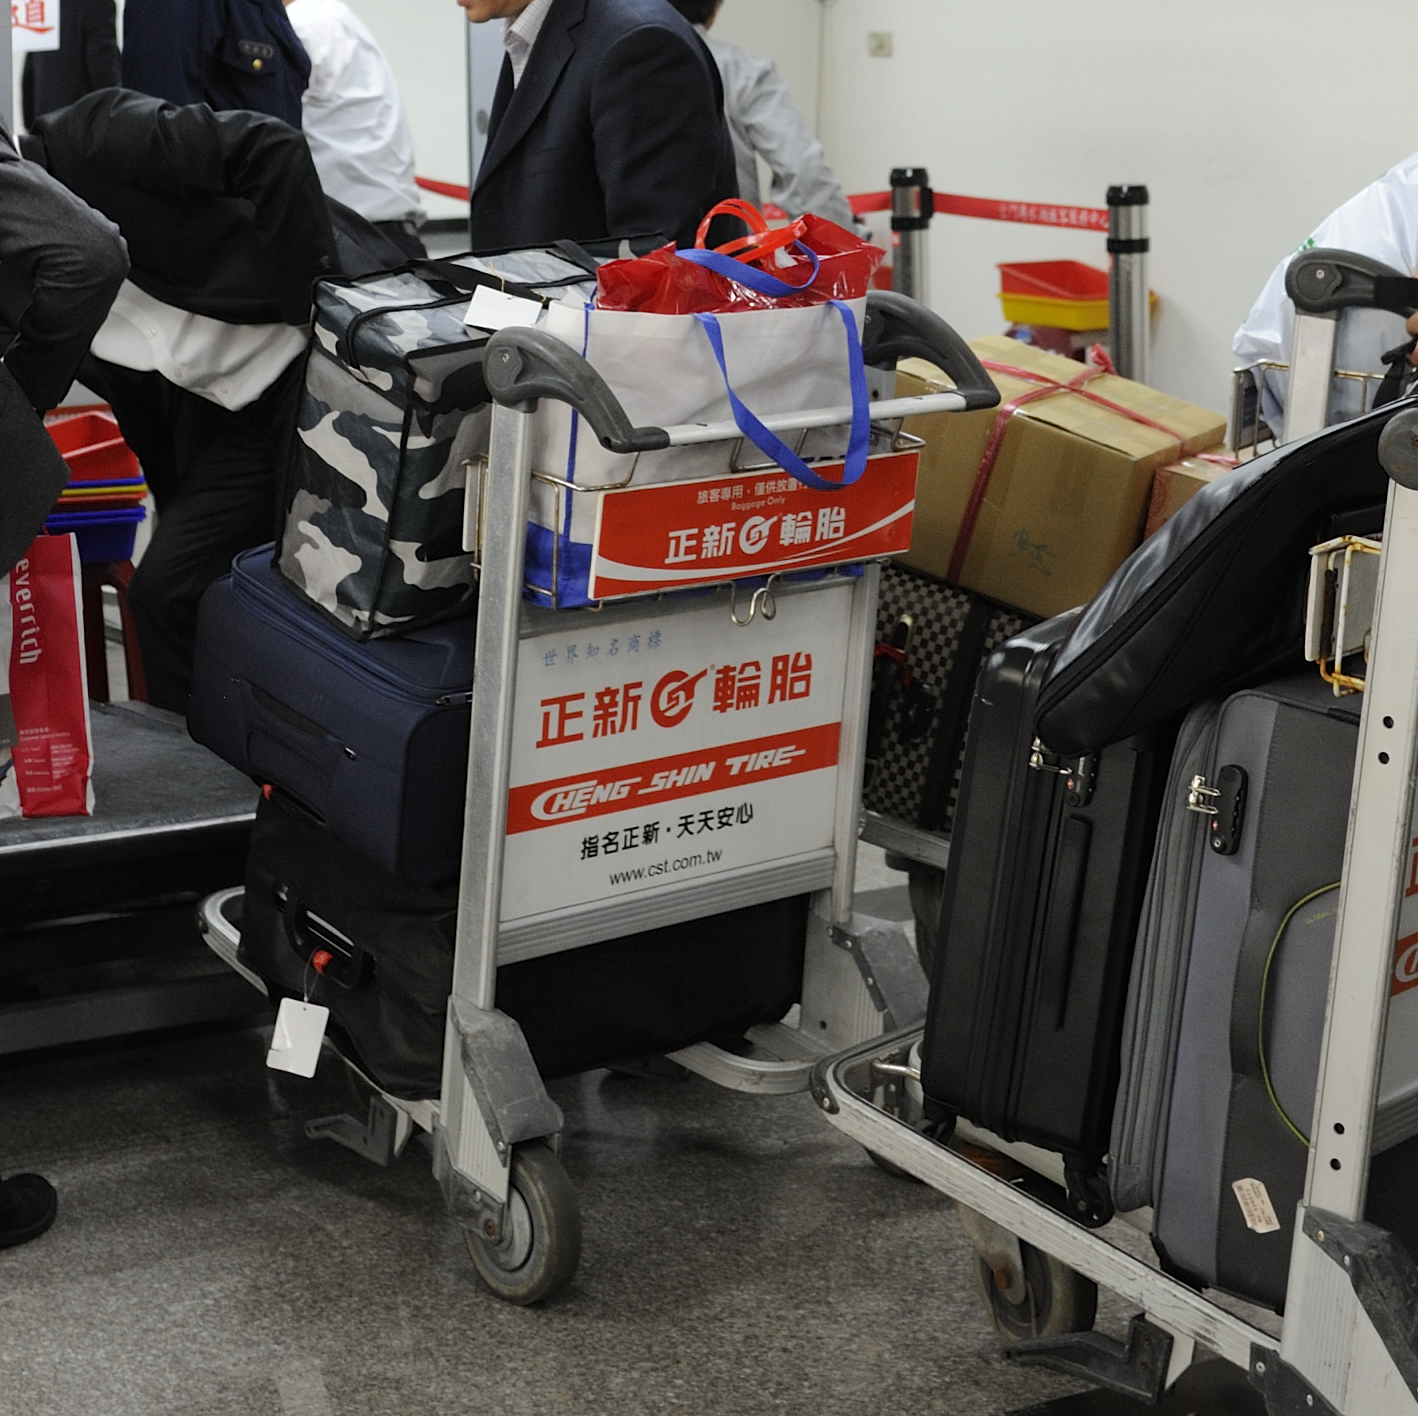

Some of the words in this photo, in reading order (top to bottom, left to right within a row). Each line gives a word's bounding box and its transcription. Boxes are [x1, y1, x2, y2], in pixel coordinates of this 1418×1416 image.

[15, 558, 43, 665] everrich
[530, 777, 643, 821] CHENG
[637, 761, 717, 795] SHIN
[725, 745, 806, 776] TIRE
[609, 849, 723, 886] www.cst.com.tw
